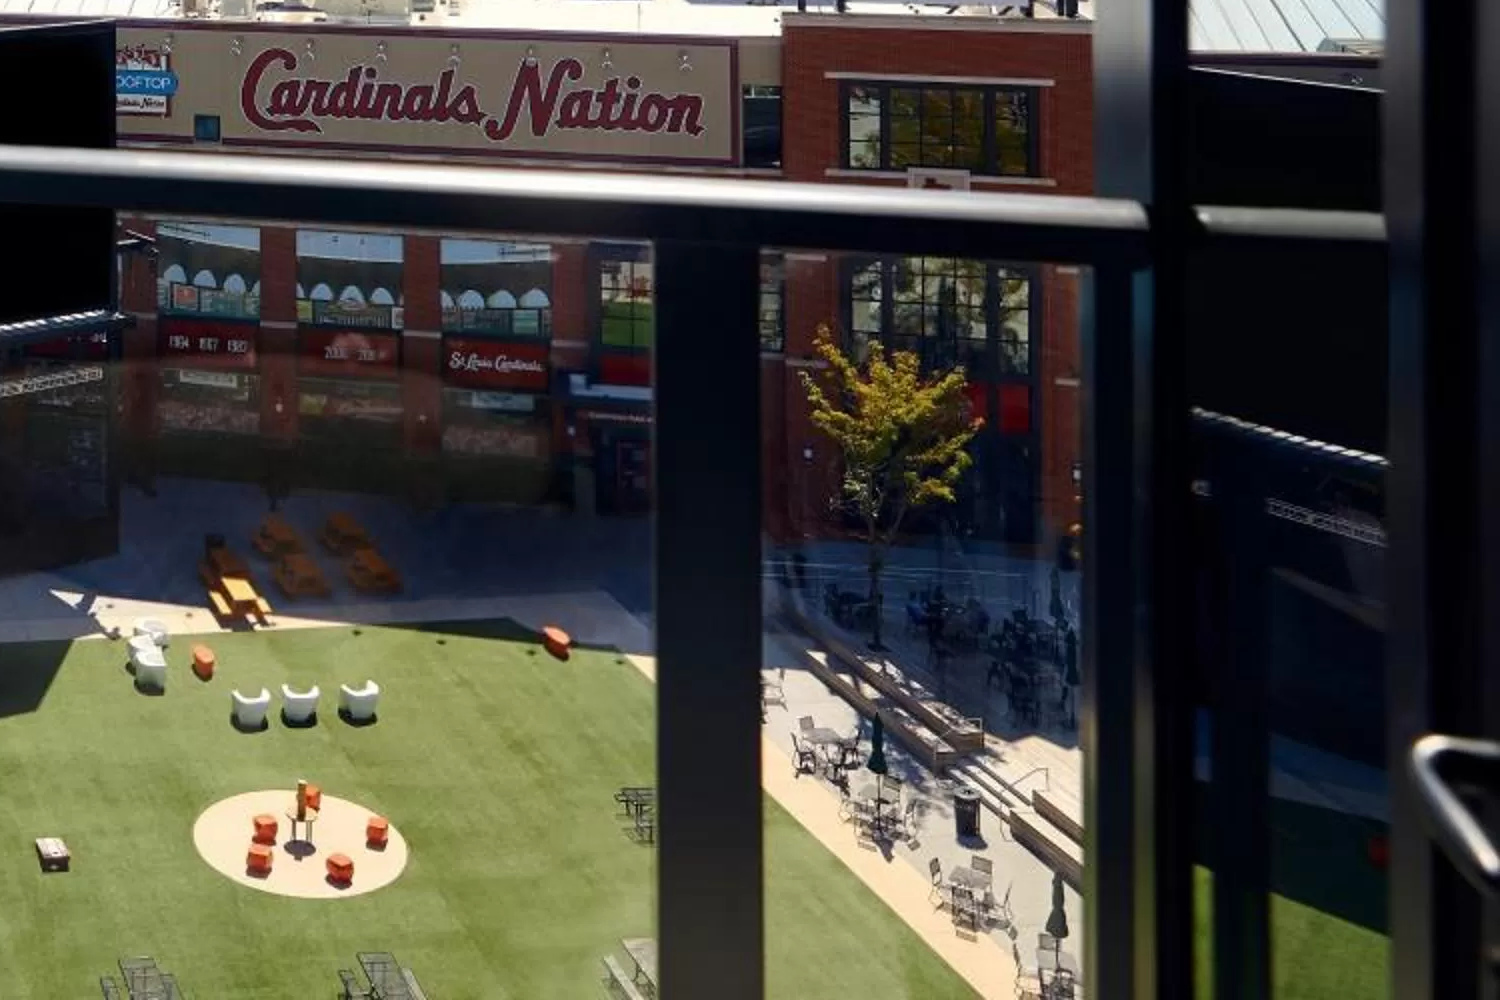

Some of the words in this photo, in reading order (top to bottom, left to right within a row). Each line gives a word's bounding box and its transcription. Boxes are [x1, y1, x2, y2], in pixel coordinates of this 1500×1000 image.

[116, 75, 171, 90] OOFTOP
[241, 46, 487, 134] Cardinals
[484, 57, 706, 141] Nation
